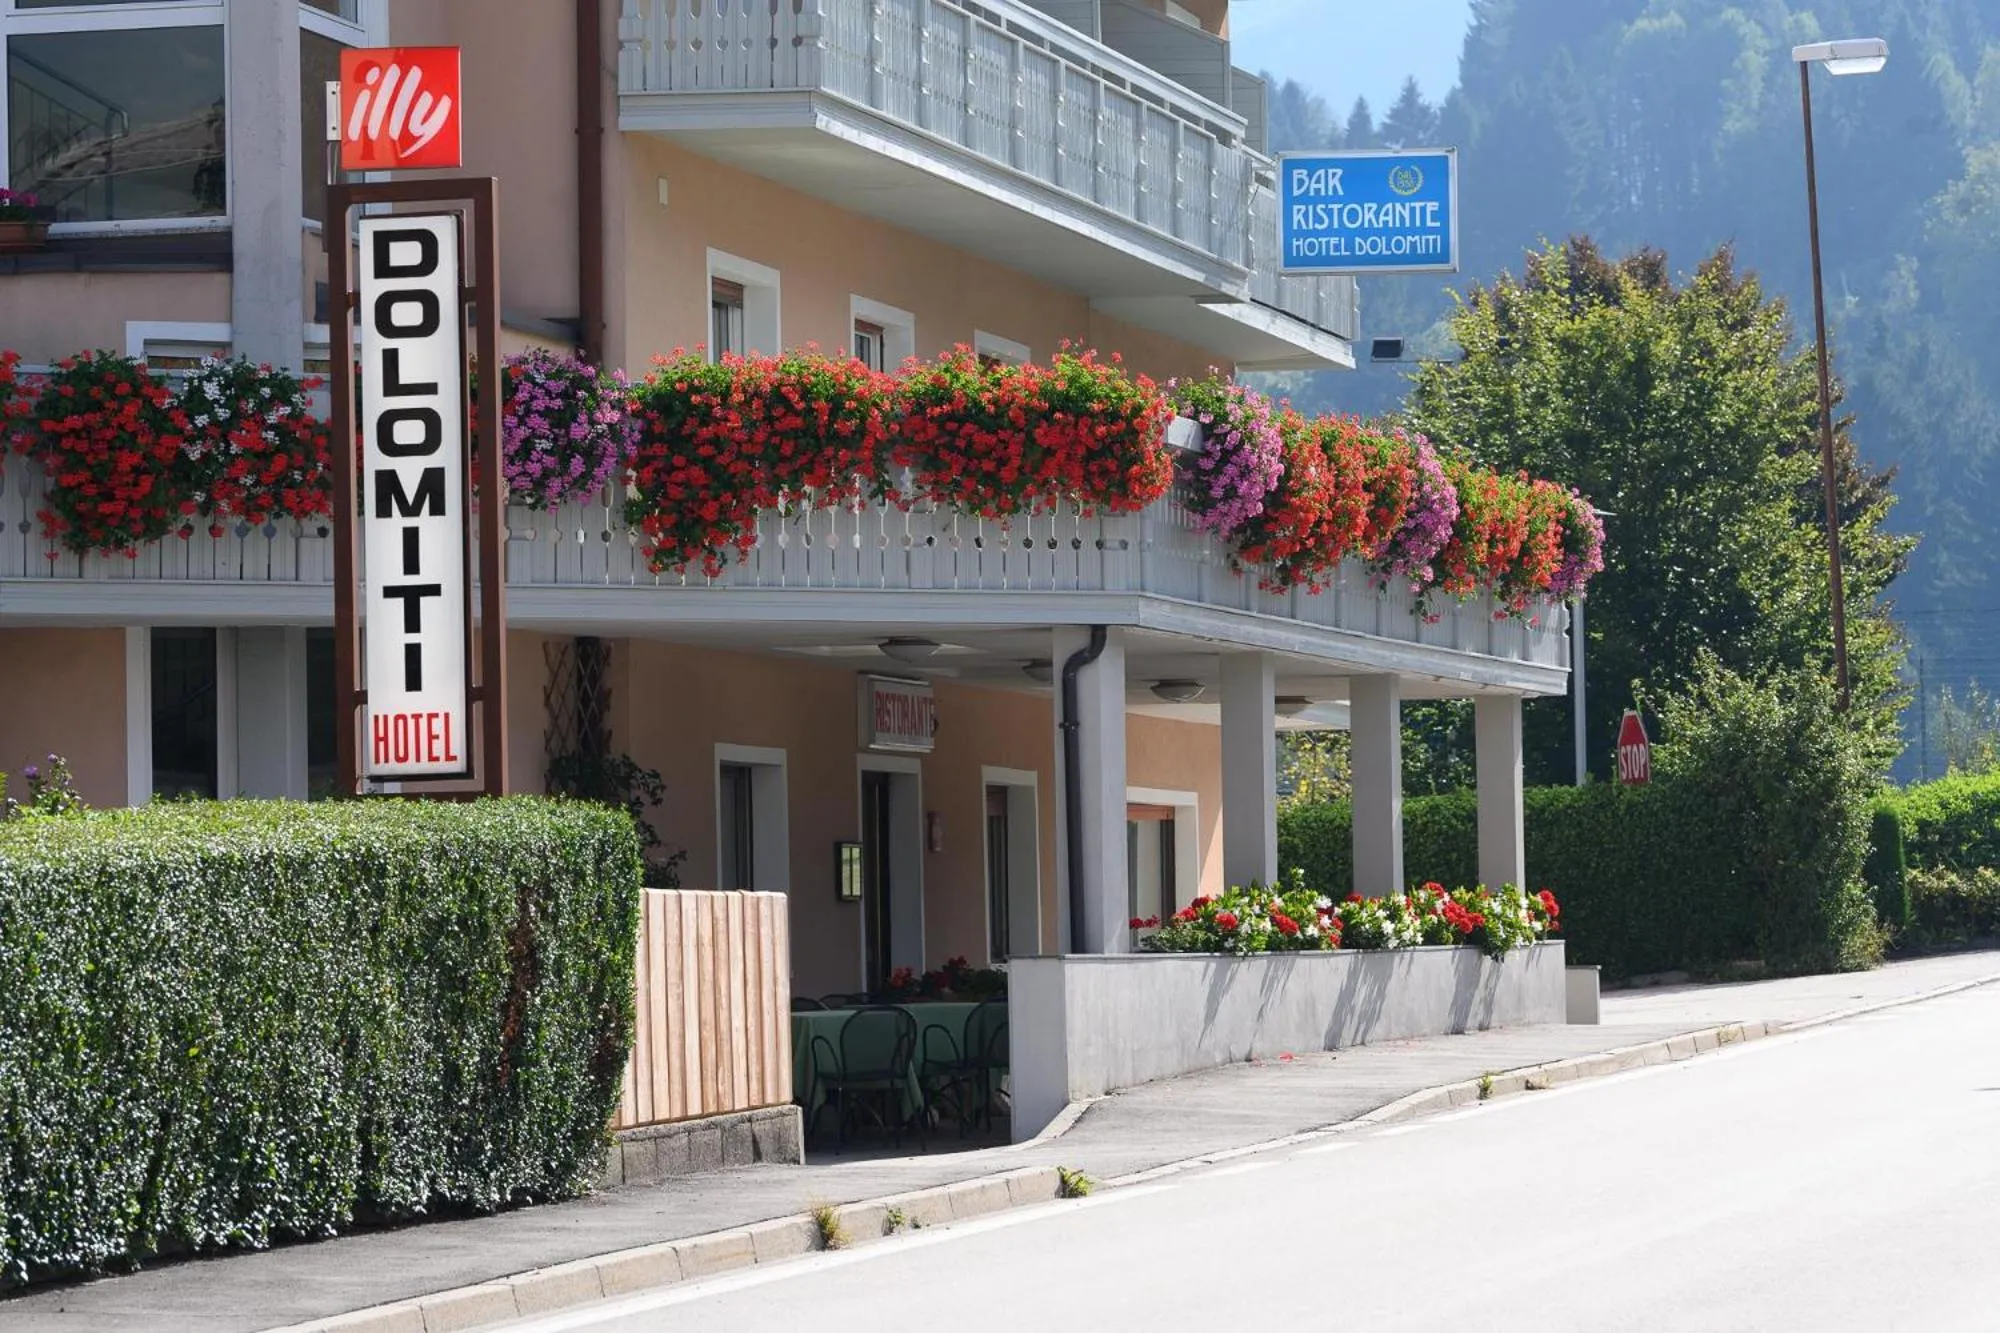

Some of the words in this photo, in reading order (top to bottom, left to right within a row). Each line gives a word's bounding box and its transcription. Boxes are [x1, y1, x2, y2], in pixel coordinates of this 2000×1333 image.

[347, 63, 453, 158] illy
[1292, 168, 1344, 197] BAR
[1292, 202, 1441, 230] RISTORANTE
[1292, 236, 1351, 257] HOTEL
[1355, 235, 1441, 256] DOLOMITI
[373, 228, 446, 692] DOLOMITI
[373, 712, 458, 765] HOTEL
[1621, 744, 1646, 779] STOP
